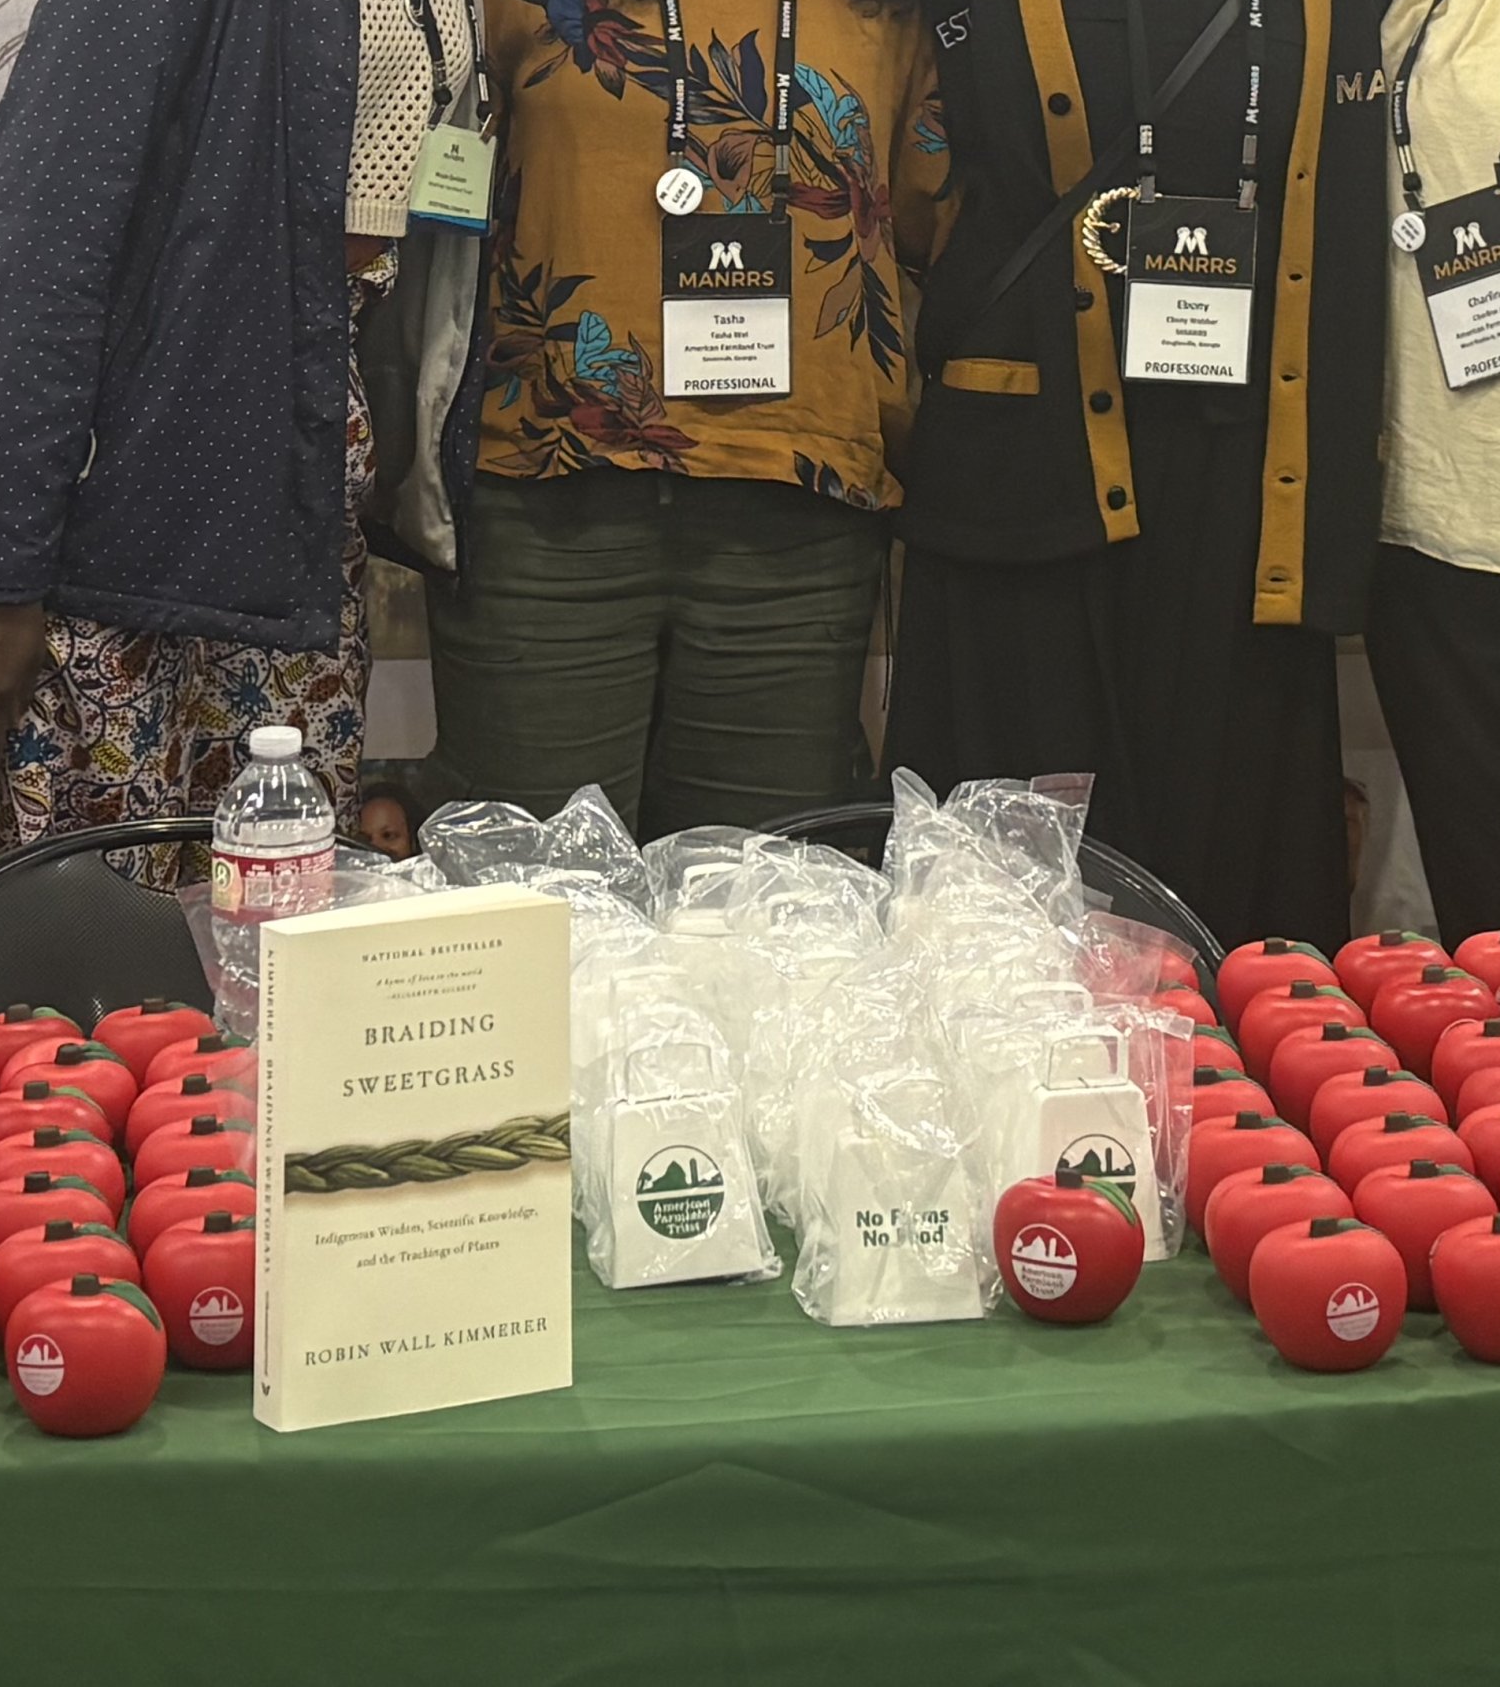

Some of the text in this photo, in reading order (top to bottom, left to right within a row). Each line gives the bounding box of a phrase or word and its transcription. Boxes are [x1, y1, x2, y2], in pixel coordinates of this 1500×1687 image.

[1145, 254, 1237, 274] MANRRS
[679, 270, 775, 289] MANRRS
[713, 314, 746, 325] Tasha
[1145, 361, 1234, 377] PROFESSIONAL
[684, 376, 777, 391] PROFESSIONAL
[364, 1014, 495, 1046] BRAIDING
[342, 1059, 515, 1098] SWEETGRASS
[856, 1210, 884, 1228] No
[863, 1229, 890, 1248] No
[357, 1255, 377, 1268] and
[379, 1252, 395, 1265] the
[453, 1242, 466, 1255] of
[304, 1317, 548, 1366] ROBIN WALL KIMMERER
